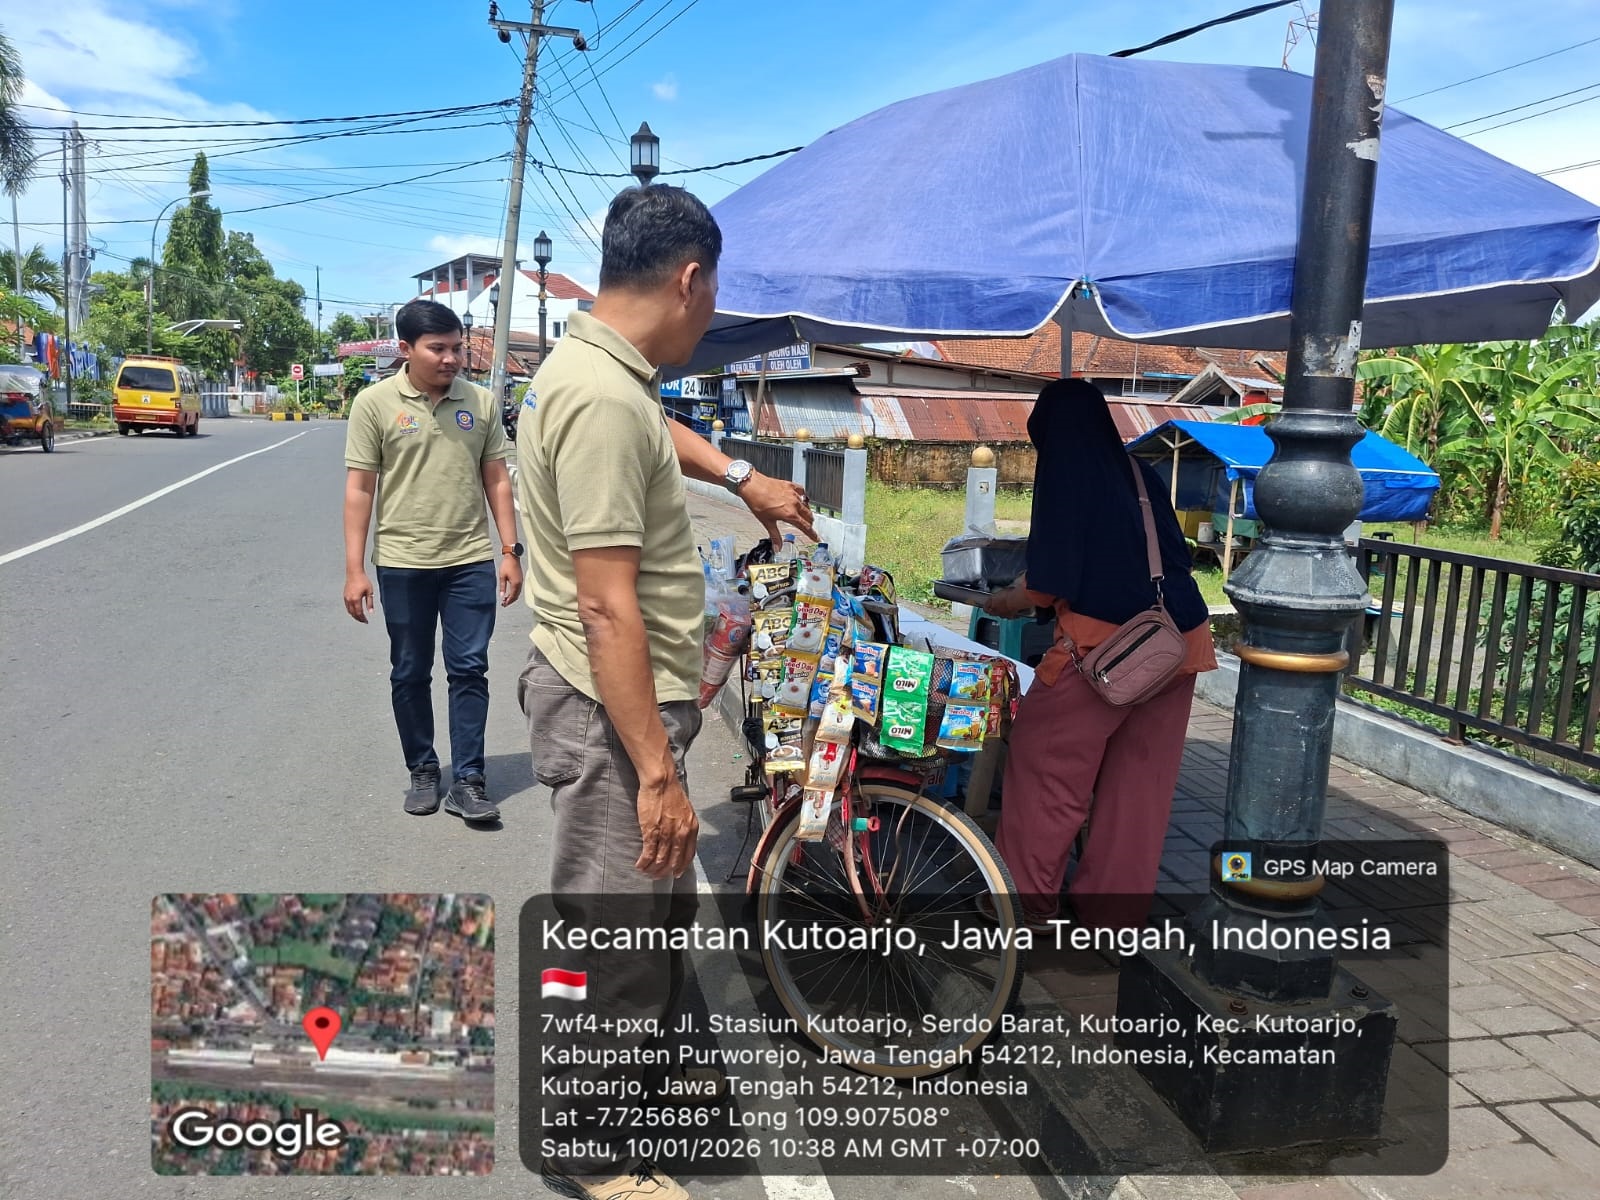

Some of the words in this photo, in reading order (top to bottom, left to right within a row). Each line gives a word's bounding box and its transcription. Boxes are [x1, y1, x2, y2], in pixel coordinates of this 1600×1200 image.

[791, 343, 809, 357] NASI
[770, 360, 785, 370] OLEH
[786, 359, 802, 369] OLEH
[684, 380, 695, 395] 24
[698, 381, 718, 397] JAM
[756, 566, 788, 580] ABC
[796, 604, 813, 614] Good
[813, 607, 827, 618] Day
[760, 617, 790, 631] ABC
[801, 662, 814, 673] Day
[895, 679, 916, 690] MILO
[768, 718, 801, 731] ABC
[891, 727, 912, 735] MILO
